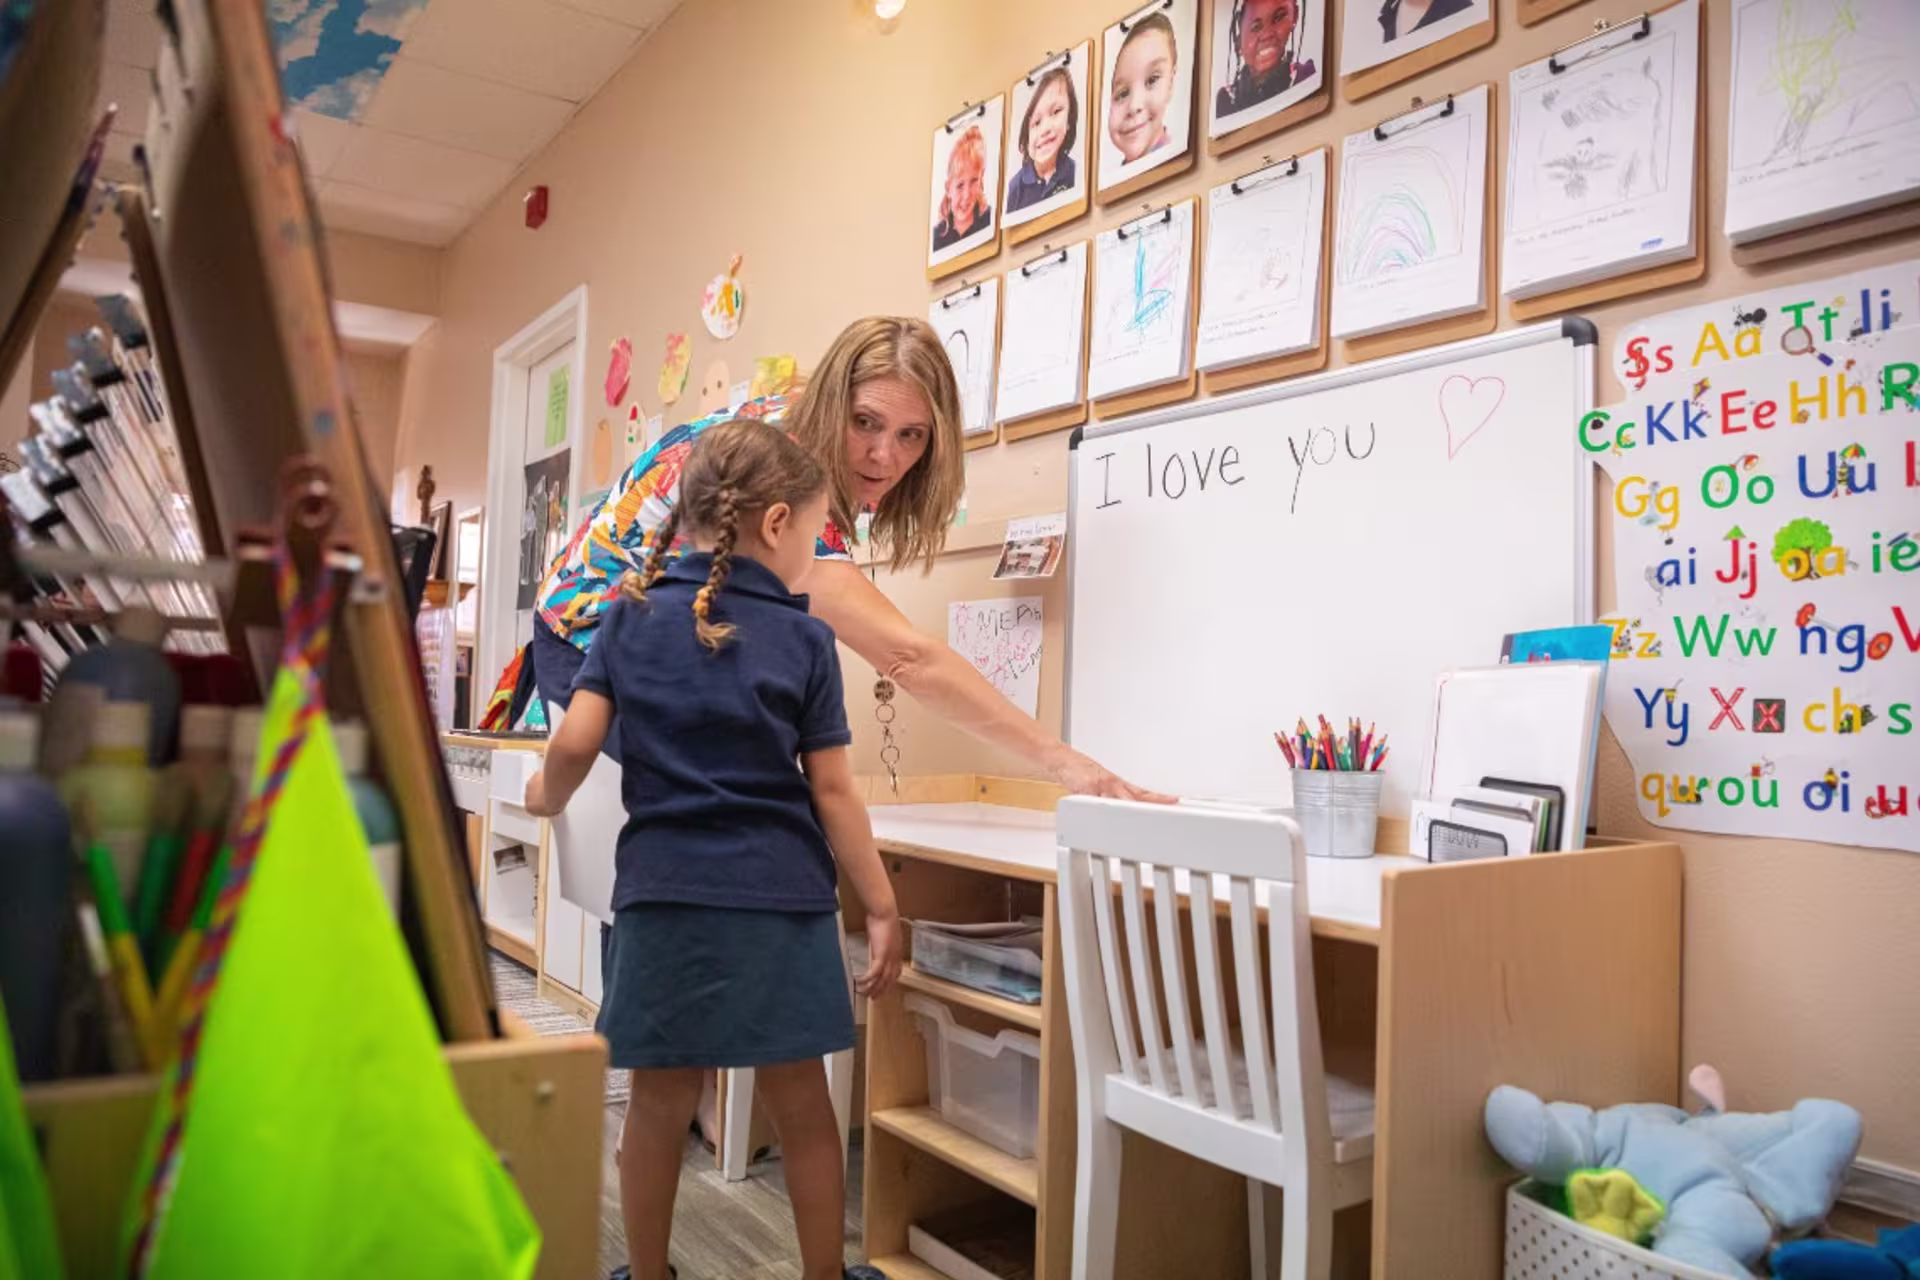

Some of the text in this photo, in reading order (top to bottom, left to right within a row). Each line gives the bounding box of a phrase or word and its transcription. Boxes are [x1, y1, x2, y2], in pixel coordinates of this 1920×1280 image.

[1625, 336, 1674, 391] Ss
[1692, 322, 1760, 366] Aa
[1781, 300, 1839, 341] Tt
[1578, 411, 1636, 453] Cc
[1646, 400, 1707, 445] Kk
[1722, 390, 1776, 434] Ee
[1790, 374, 1866, 424] Hh
[1095, 421, 1375, 514] I love you
[1616, 476, 1680, 530] Gg
[1702, 466, 1774, 508] Oo
[1798, 451, 1876, 499] Uu
[1656, 547, 1697, 587] ai
[1716, 540, 1756, 599] Jj
[1780, 546, 1846, 580] oa
[1601, 618, 1661, 660] Zz
[1674, 614, 1776, 656] Ww
[1799, 623, 1865, 672] ng
[1634, 687, 1689, 747] Yy
[1709, 687, 1784, 732] Xx
[1802, 687, 1863, 733] ch
[1641, 772, 1696, 818] qu
[1717, 776, 1779, 808] ou
[1803, 771, 1850, 813] oi
